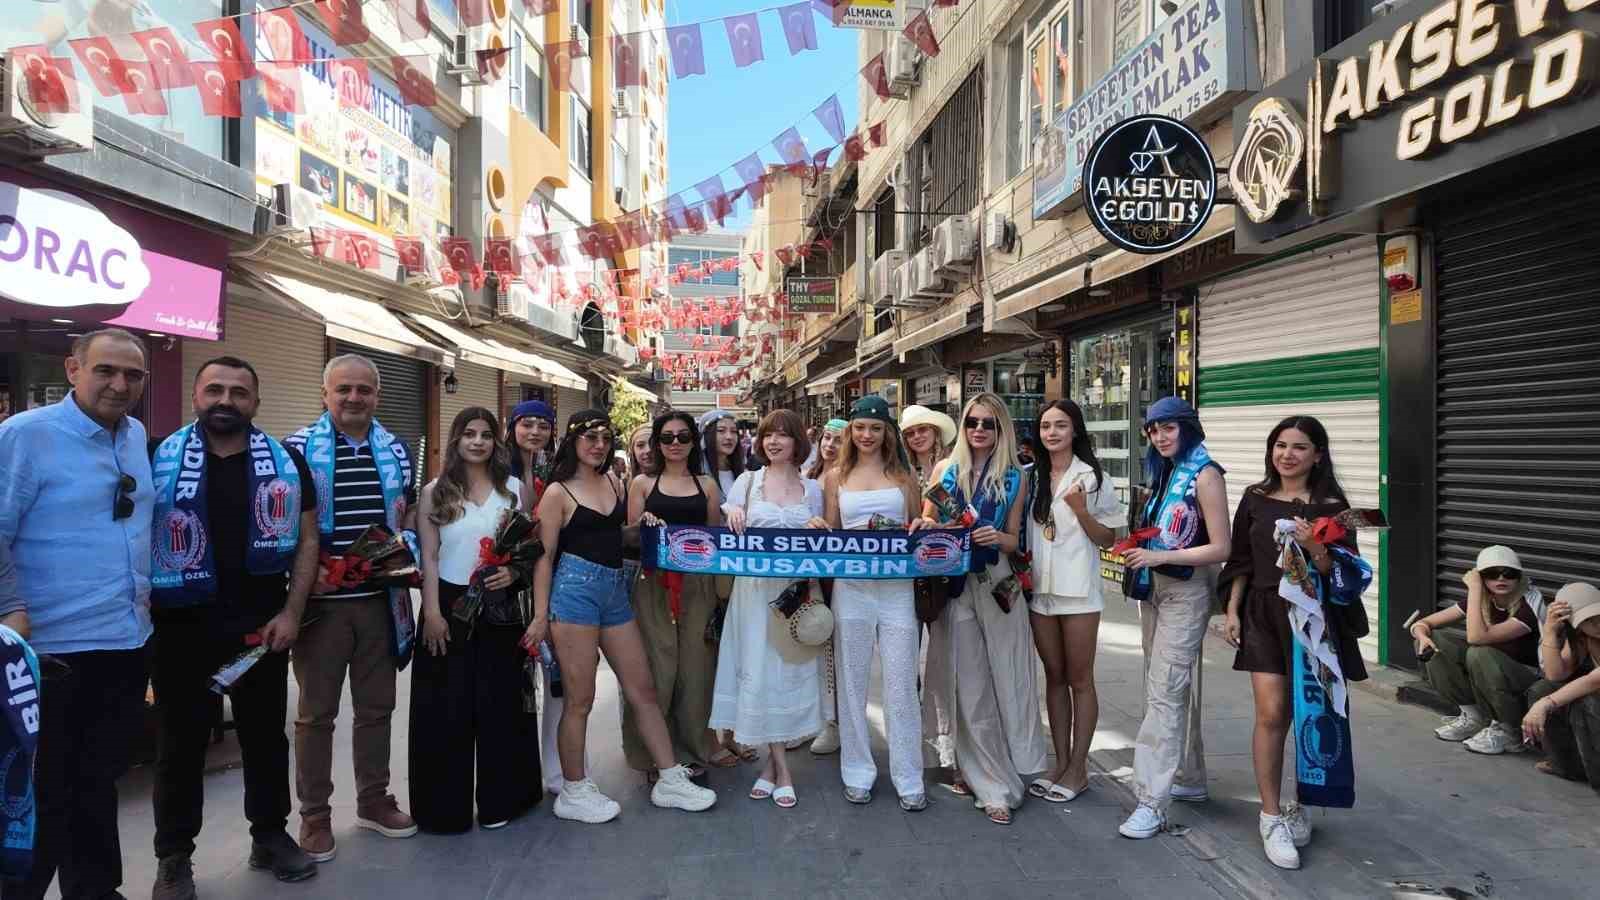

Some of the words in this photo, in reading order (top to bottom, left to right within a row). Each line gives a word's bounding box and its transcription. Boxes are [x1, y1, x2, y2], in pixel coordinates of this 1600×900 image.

[844, 8, 892, 19] ALMANCA
[1132, 38, 1210, 115] EMLAK
[1323, 0, 1600, 133] AKSEV
[1204, 79, 1218, 101] 52
[1396, 30, 1583, 161] GOLD
[1094, 176, 1210, 199] AKSEVEN
[789, 282, 809, 293] THY
[773, 536, 908, 553] SEVDADIR
[720, 556, 907, 575] NUSAYBİN
[5, 657, 40, 734] BİR
